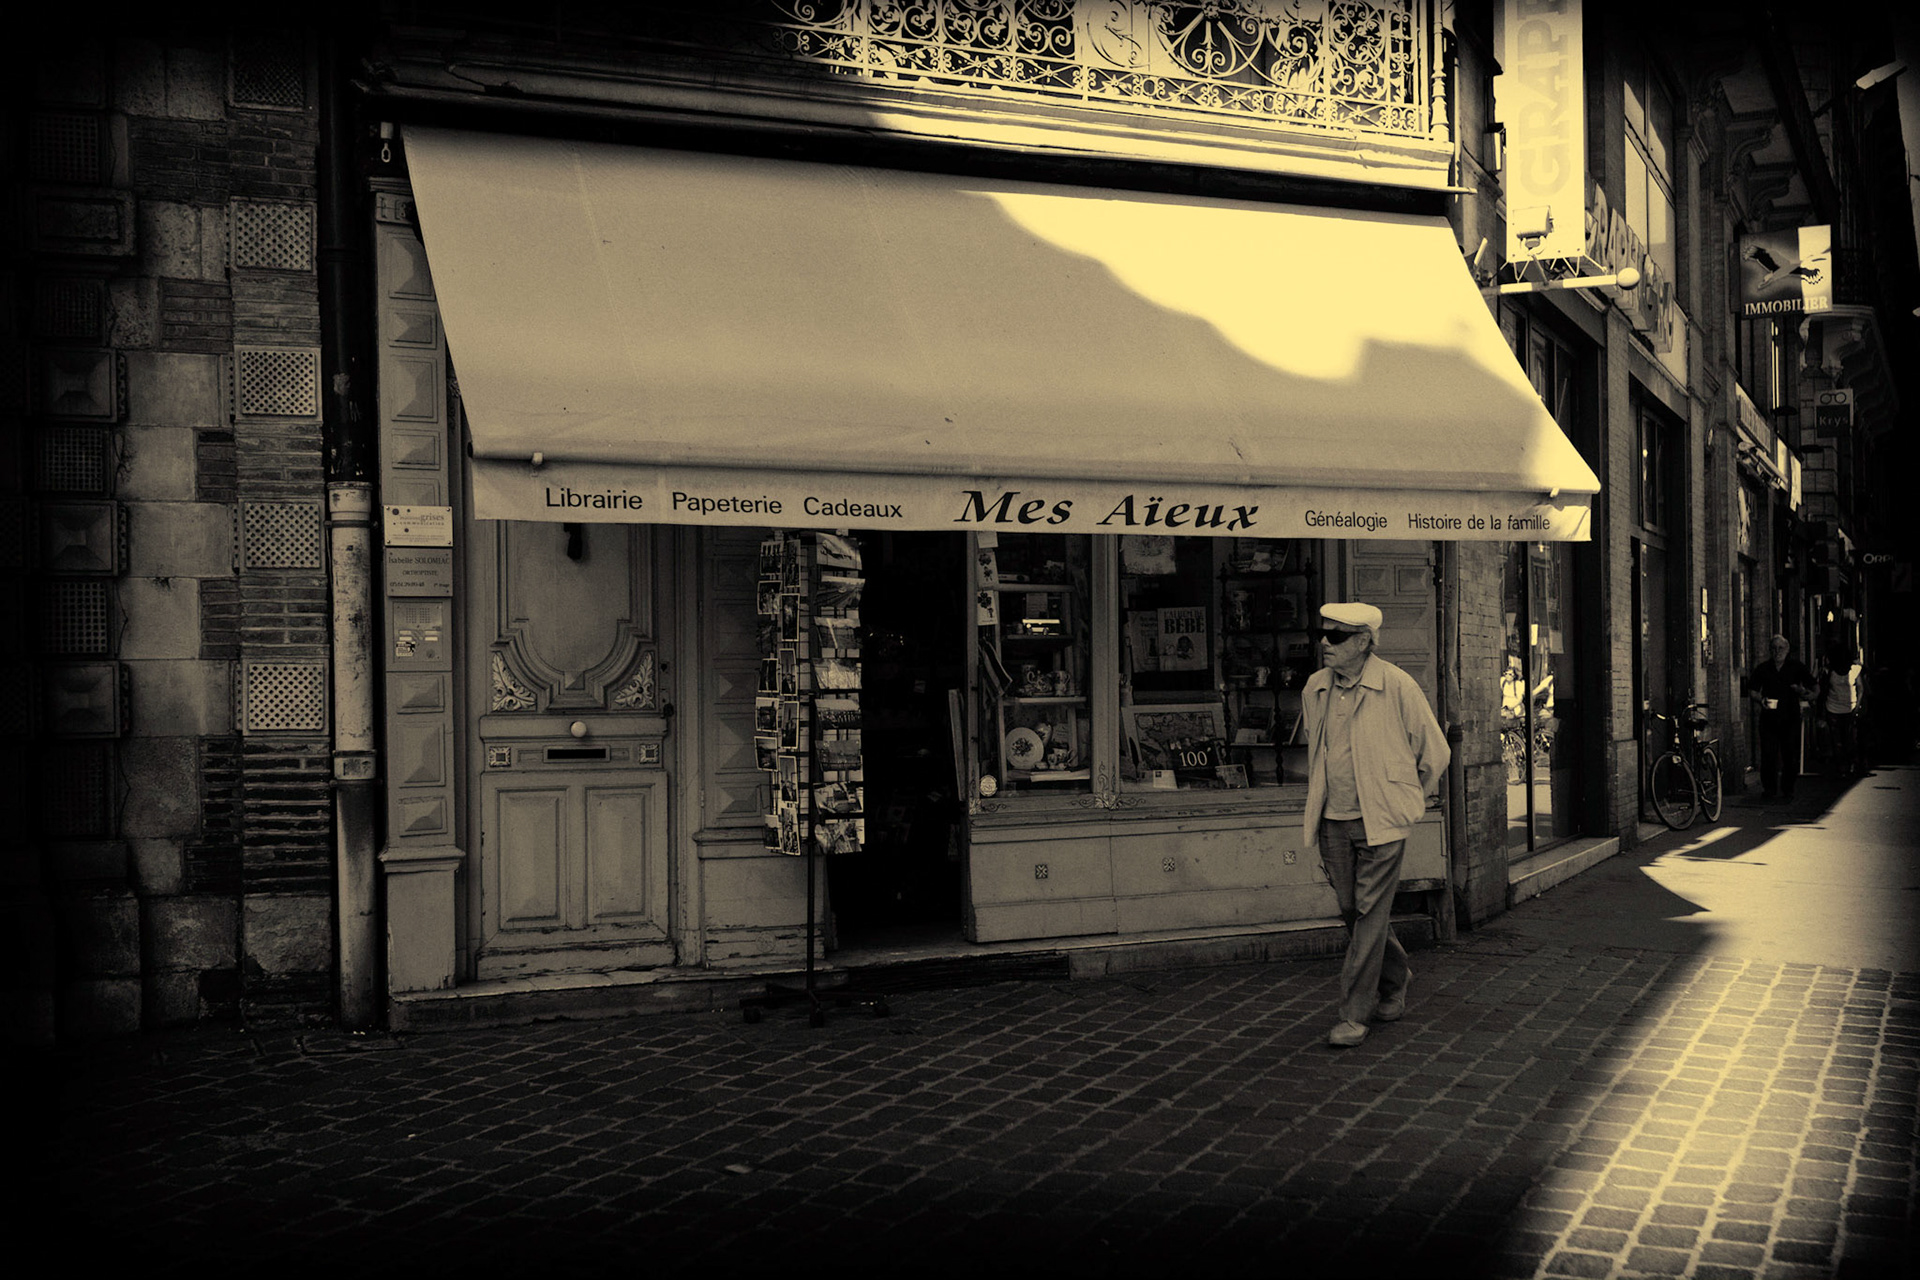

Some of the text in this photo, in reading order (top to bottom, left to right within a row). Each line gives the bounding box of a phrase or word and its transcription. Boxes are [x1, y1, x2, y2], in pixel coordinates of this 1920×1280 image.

[1744, 296, 1829, 316] IMMOBILIER
[545, 487, 904, 519] Librairie Papeterie Cadeaux
[952, 489, 1260, 532] Mes Aïeux
[1304, 509, 1551, 532] Généalogie Histoire de la famille
